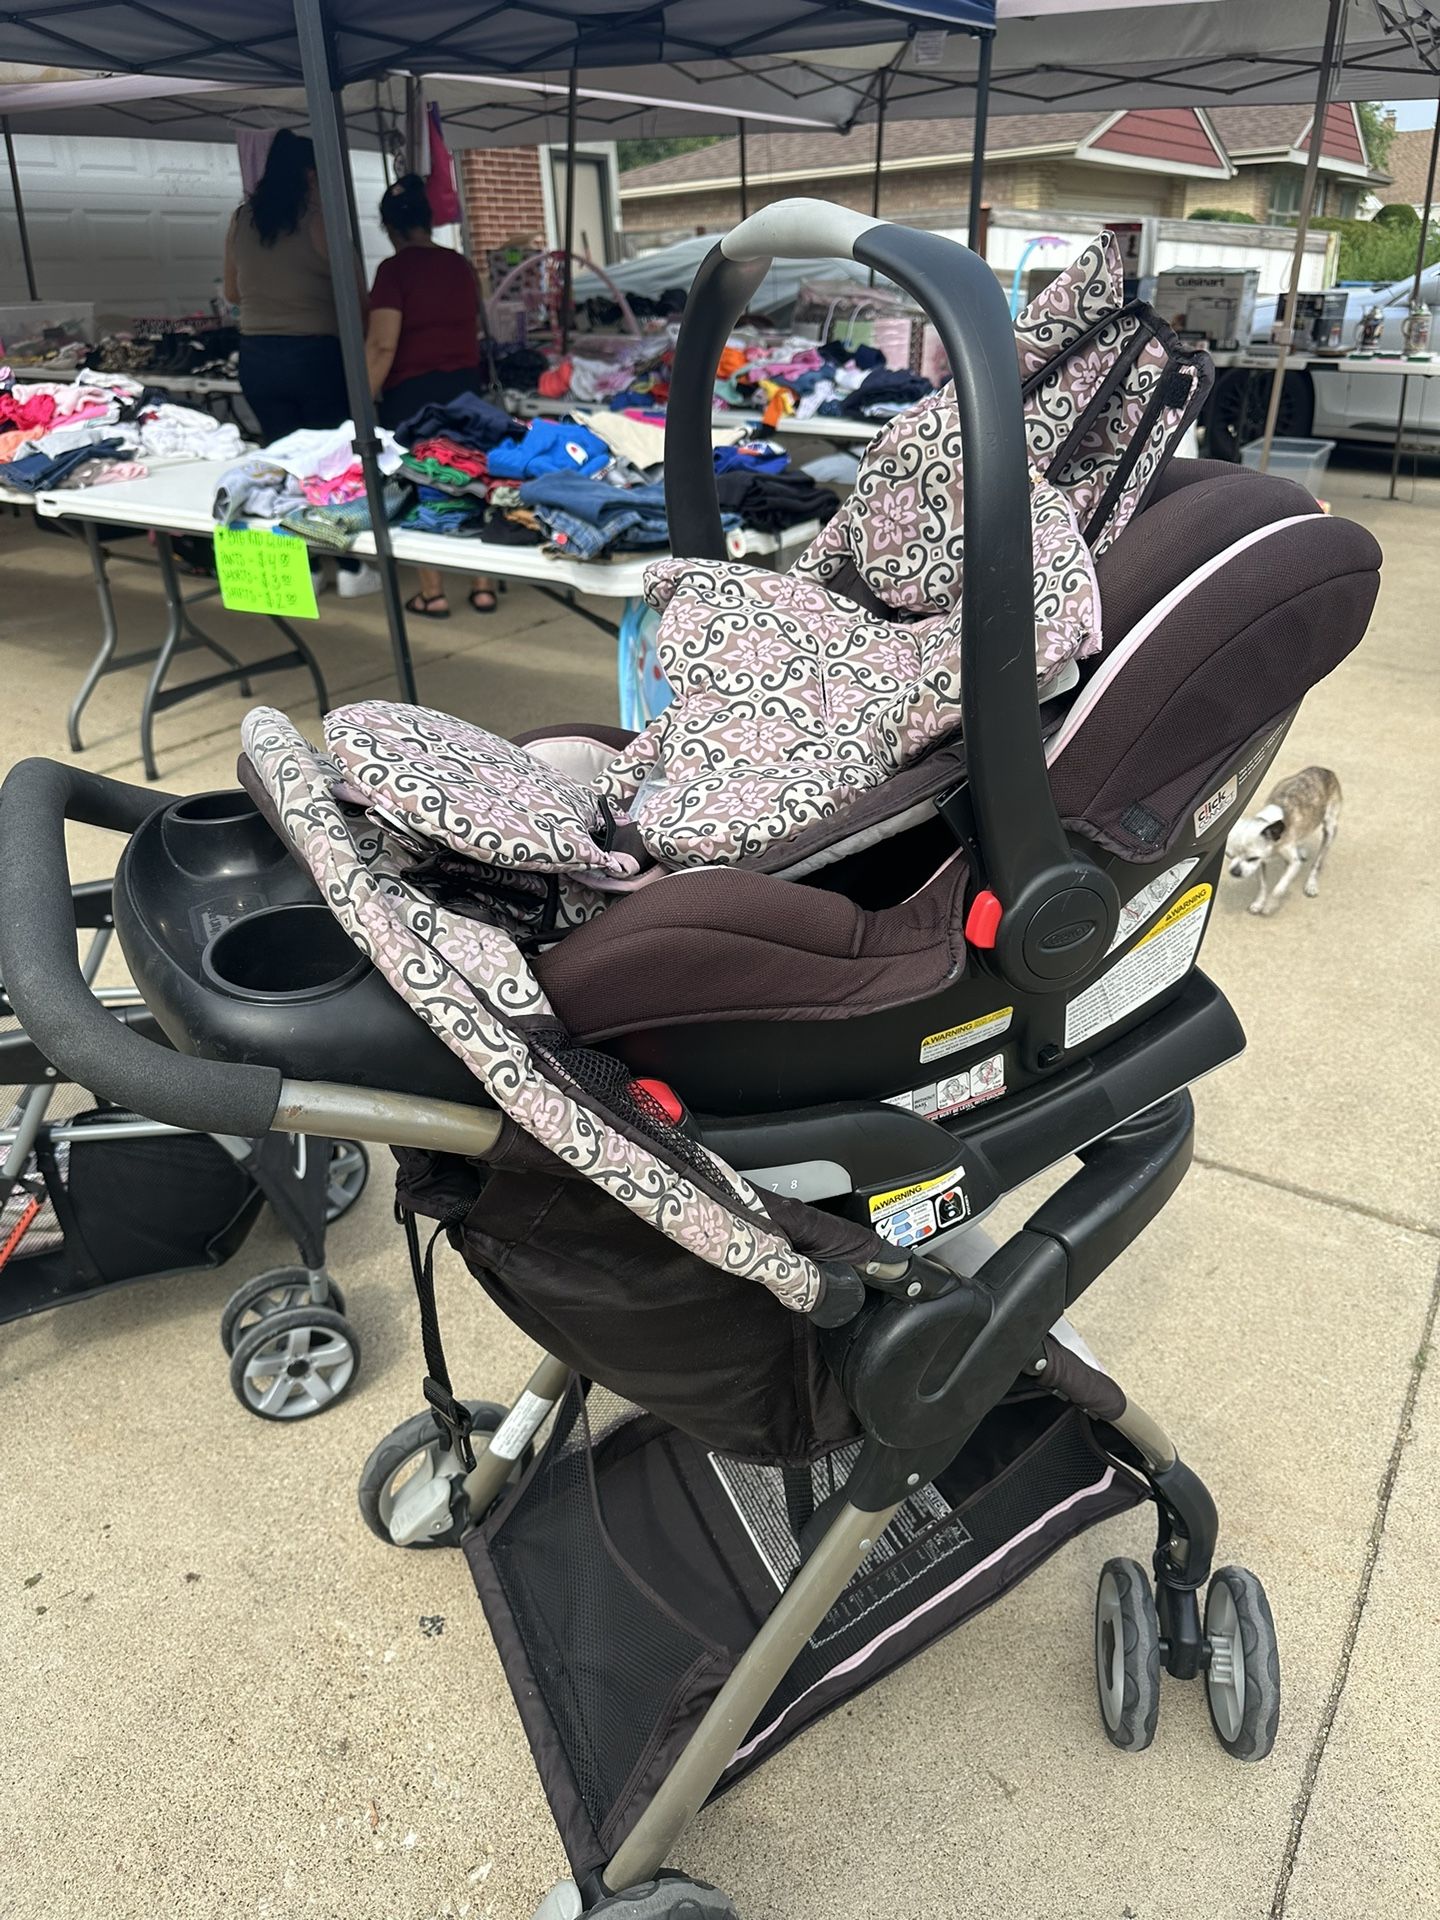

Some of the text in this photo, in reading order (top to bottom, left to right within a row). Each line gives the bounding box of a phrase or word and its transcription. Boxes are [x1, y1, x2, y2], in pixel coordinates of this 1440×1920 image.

[1175, 277, 1225, 287] Cuisinart
[1172, 889, 1207, 918] WARNING
[931, 1023, 973, 1044] WARNING
[771, 1179, 798, 1193] 7 8
[878, 1185, 922, 1209] WARNING
